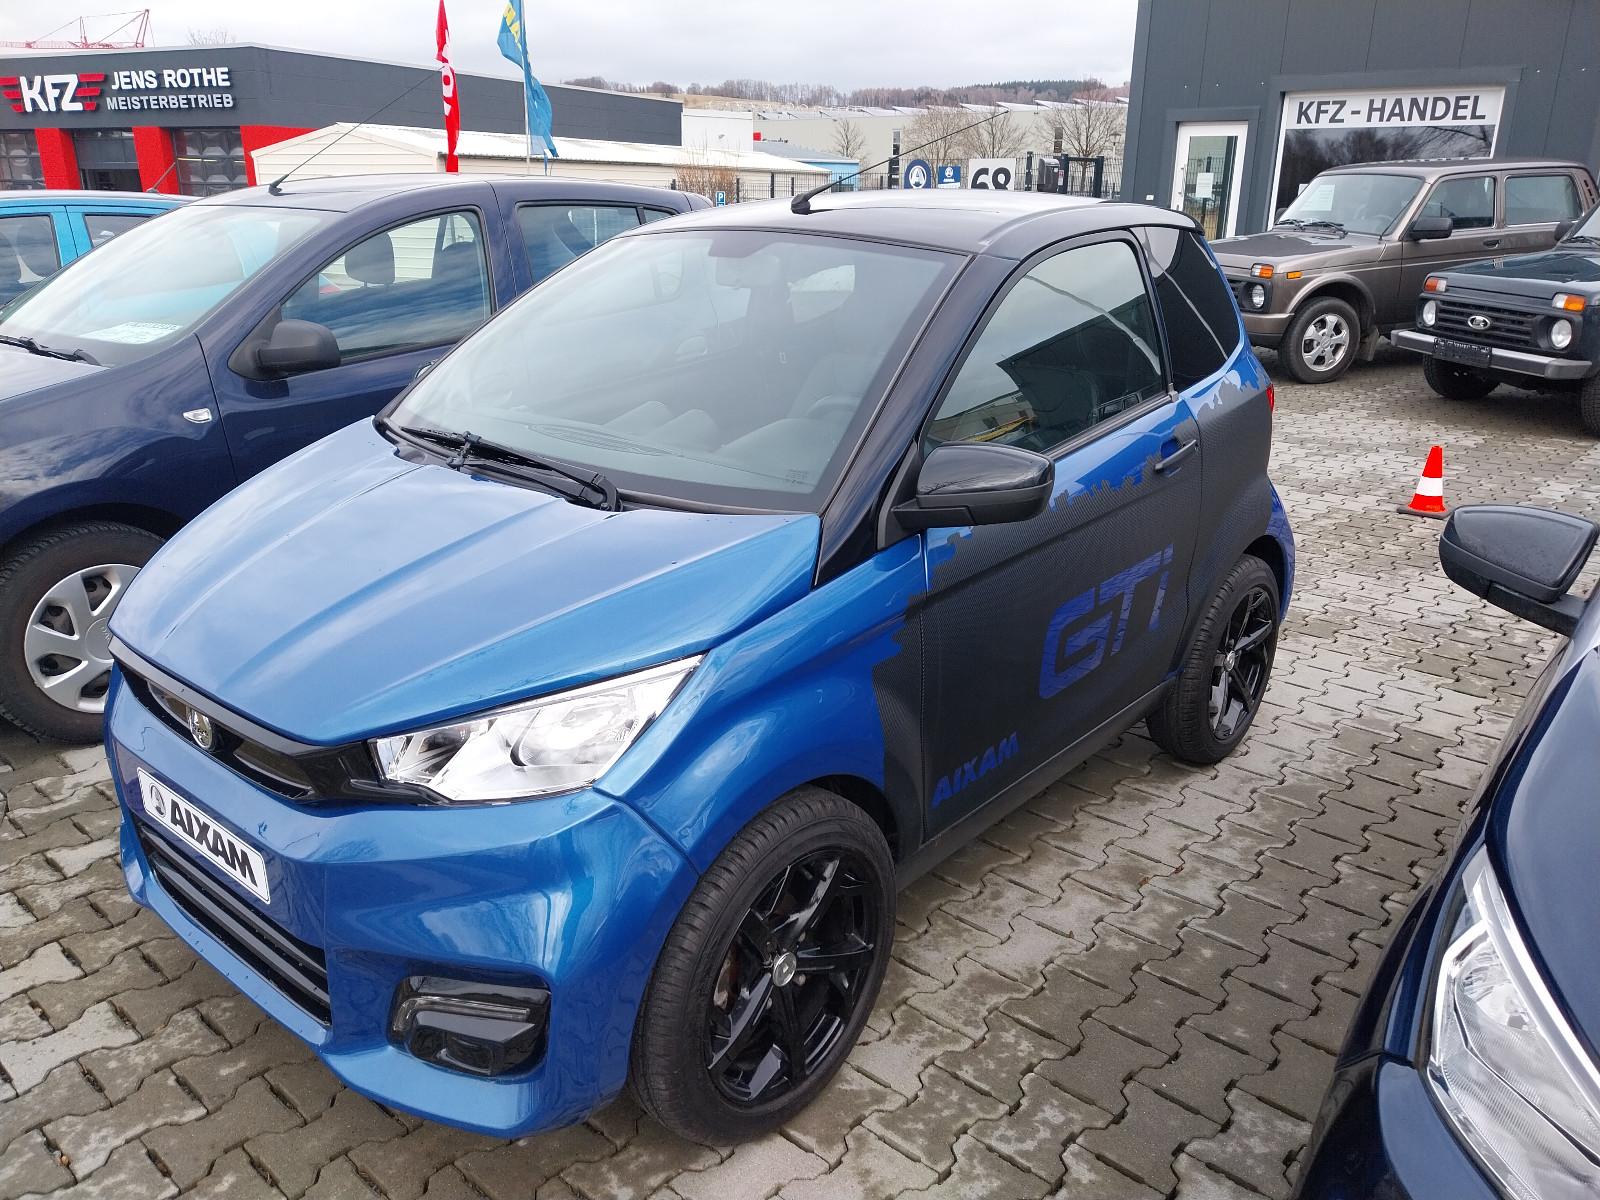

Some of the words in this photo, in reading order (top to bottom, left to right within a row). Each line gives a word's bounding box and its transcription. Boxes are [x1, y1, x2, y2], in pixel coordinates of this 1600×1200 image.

[20, 74, 84, 113] KFZ
[111, 71, 158, 90] JENS
[163, 67, 231, 88] ROTHE
[106, 93, 234, 111] MEISTERBETRIEB
[931, 731, 1020, 810] AIXAM
[170, 798, 258, 889] AIXAM
